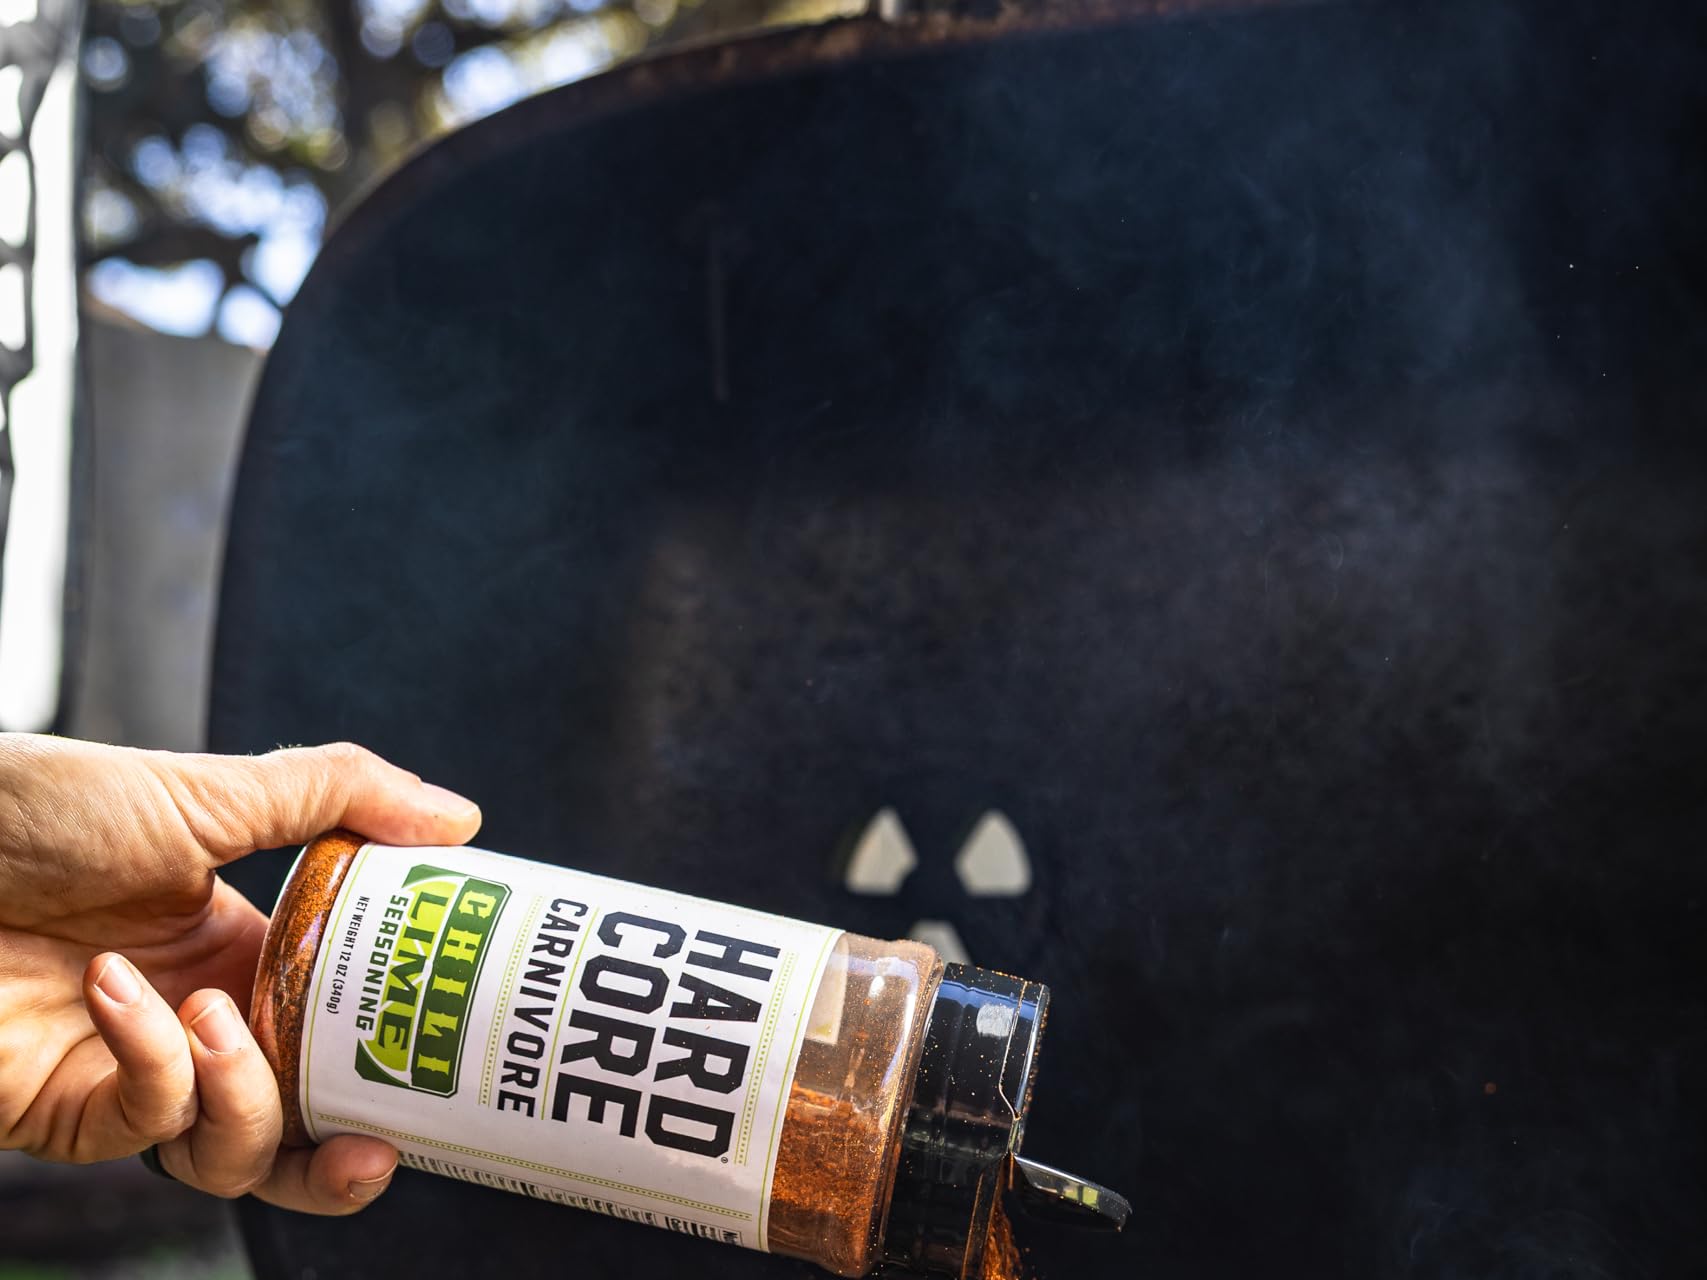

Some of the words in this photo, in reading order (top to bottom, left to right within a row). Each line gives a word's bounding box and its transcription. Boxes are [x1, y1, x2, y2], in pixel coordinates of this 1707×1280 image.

[335, 963, 349, 977] OZ
[339, 951, 352, 962] 12
[343, 914, 364, 949] WEIGHT
[355, 895, 371, 912] NET
[355, 894, 409, 1032] SEASONING
[377, 891, 449, 1051] LIME
[326, 978, 346, 1014] (340g)
[417, 890, 497, 1075] CHILI
[497, 898, 589, 1118] CARNIVORE
[551, 911, 687, 1139] CORE
[644, 929, 782, 1159] HARD
